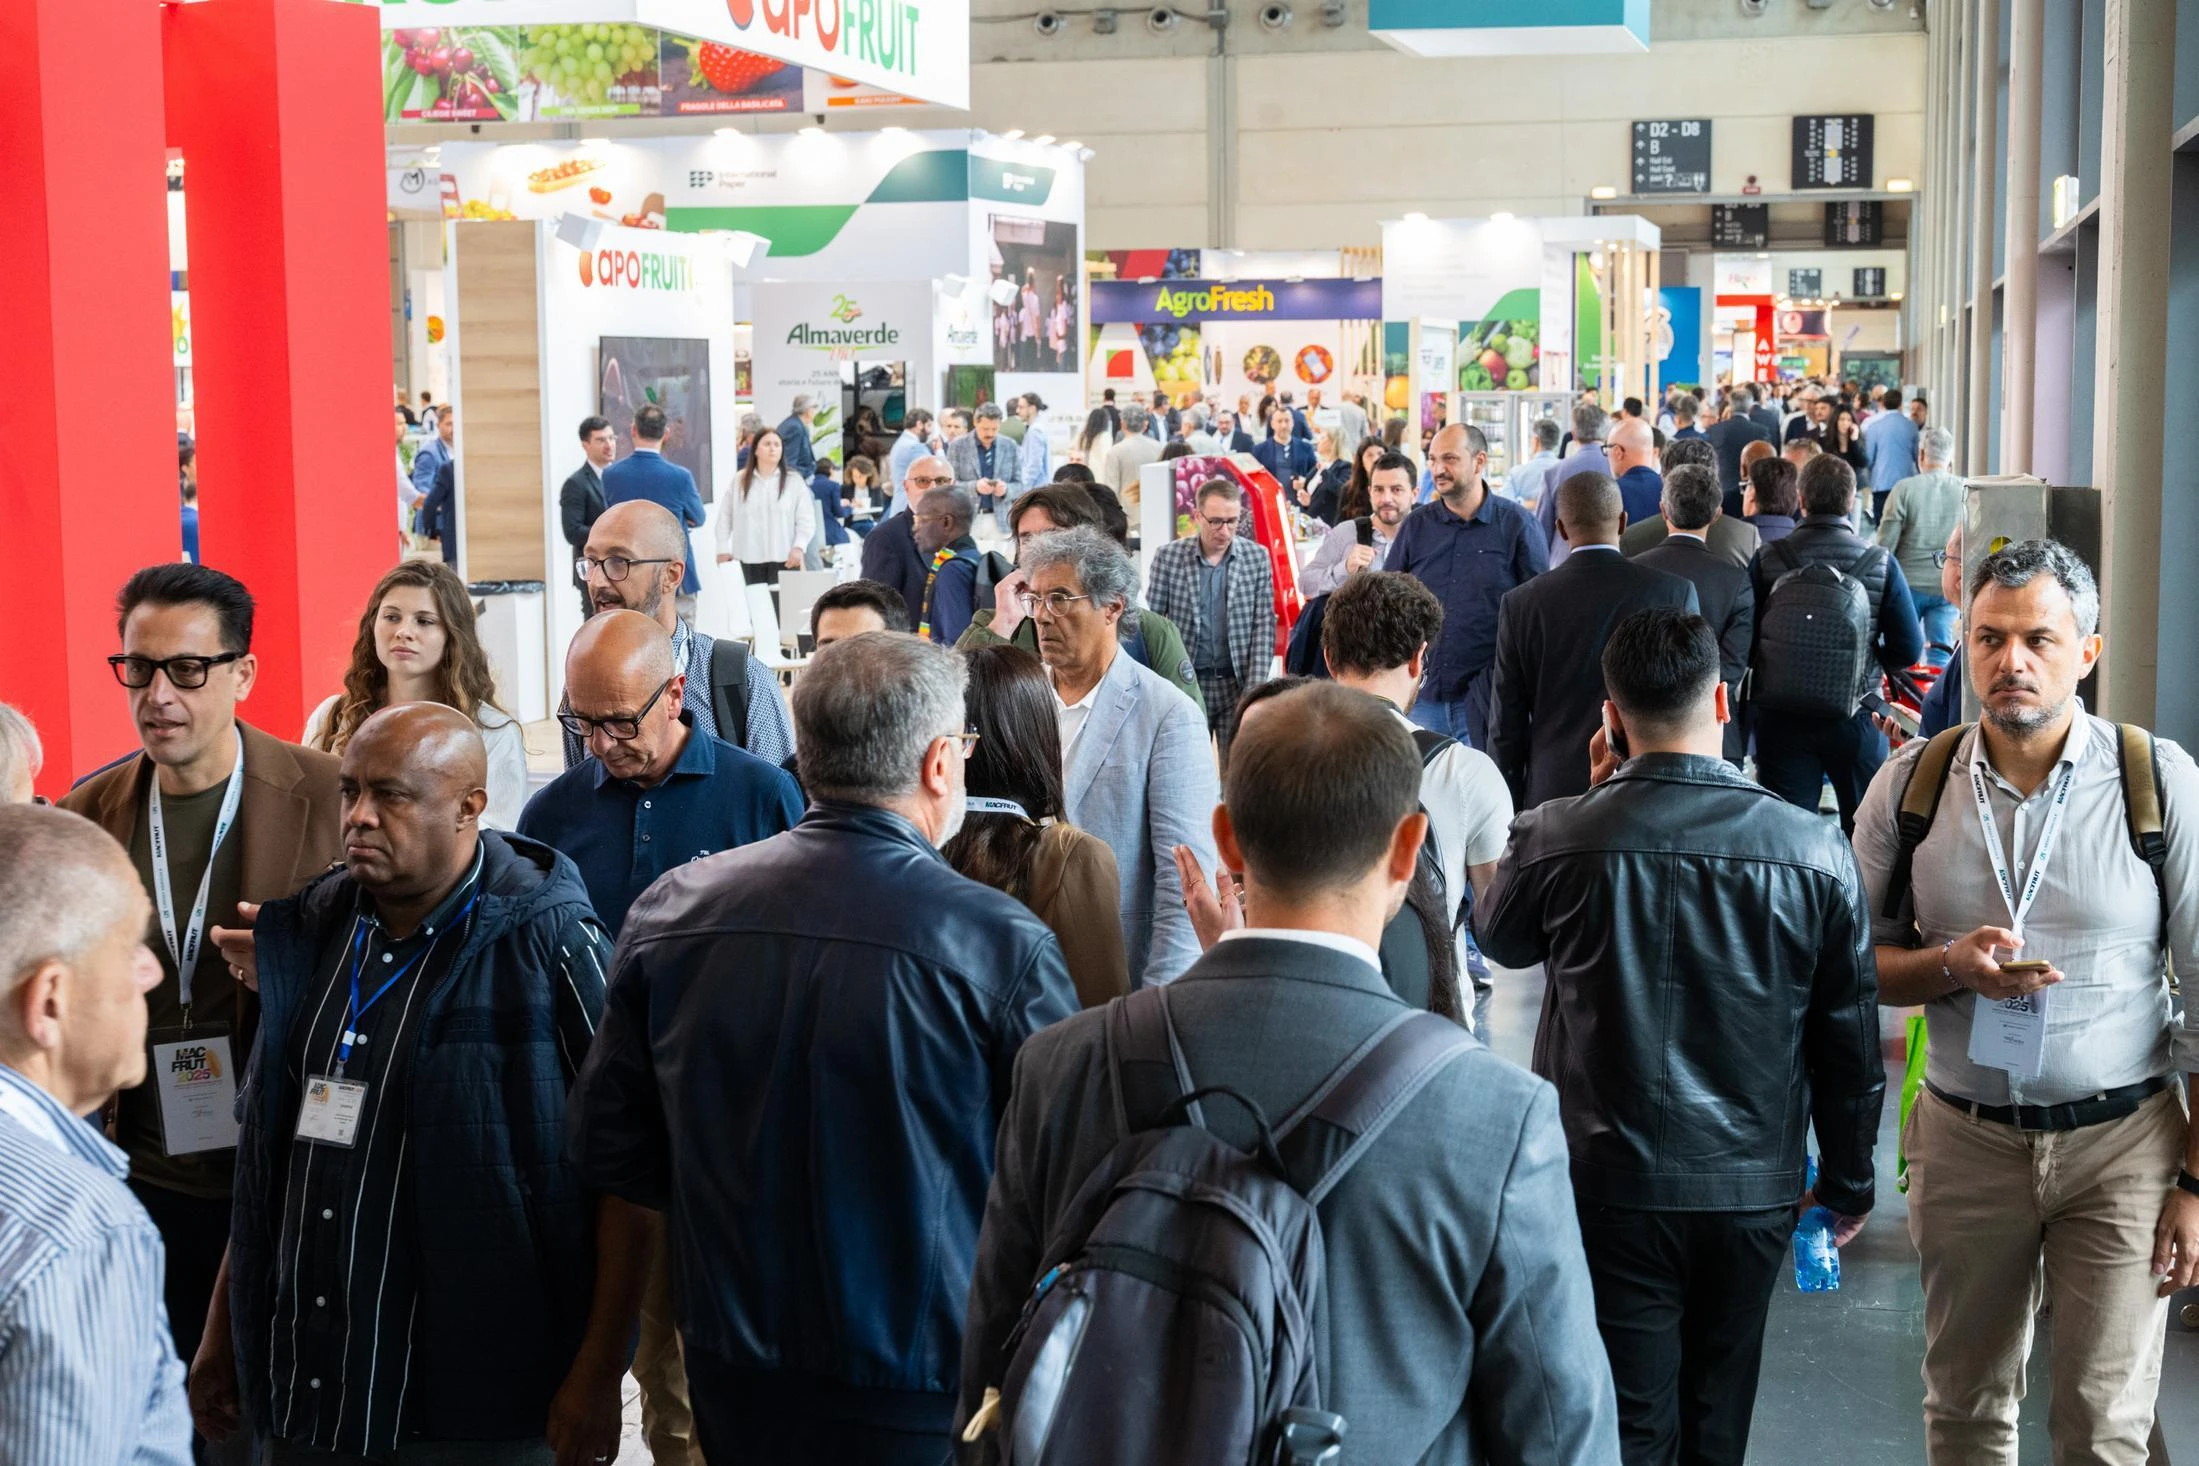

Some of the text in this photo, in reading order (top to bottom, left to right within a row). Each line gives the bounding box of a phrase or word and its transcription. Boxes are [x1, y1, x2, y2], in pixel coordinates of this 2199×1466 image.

[681, 99, 784, 112] FRAGOLE DELLA BASILICATA
[1649, 122, 1669, 138] D2
[1650, 139, 1660, 155] B
[1155, 284, 1274, 318] AgroFresh
[786, 322, 899, 344] Almaverde
[985, 801, 1018, 811] MACFRUT
[175, 1046, 206, 1061] MAC
[171, 1058, 206, 1073] FRUT
[177, 1069, 211, 1083] 2025
